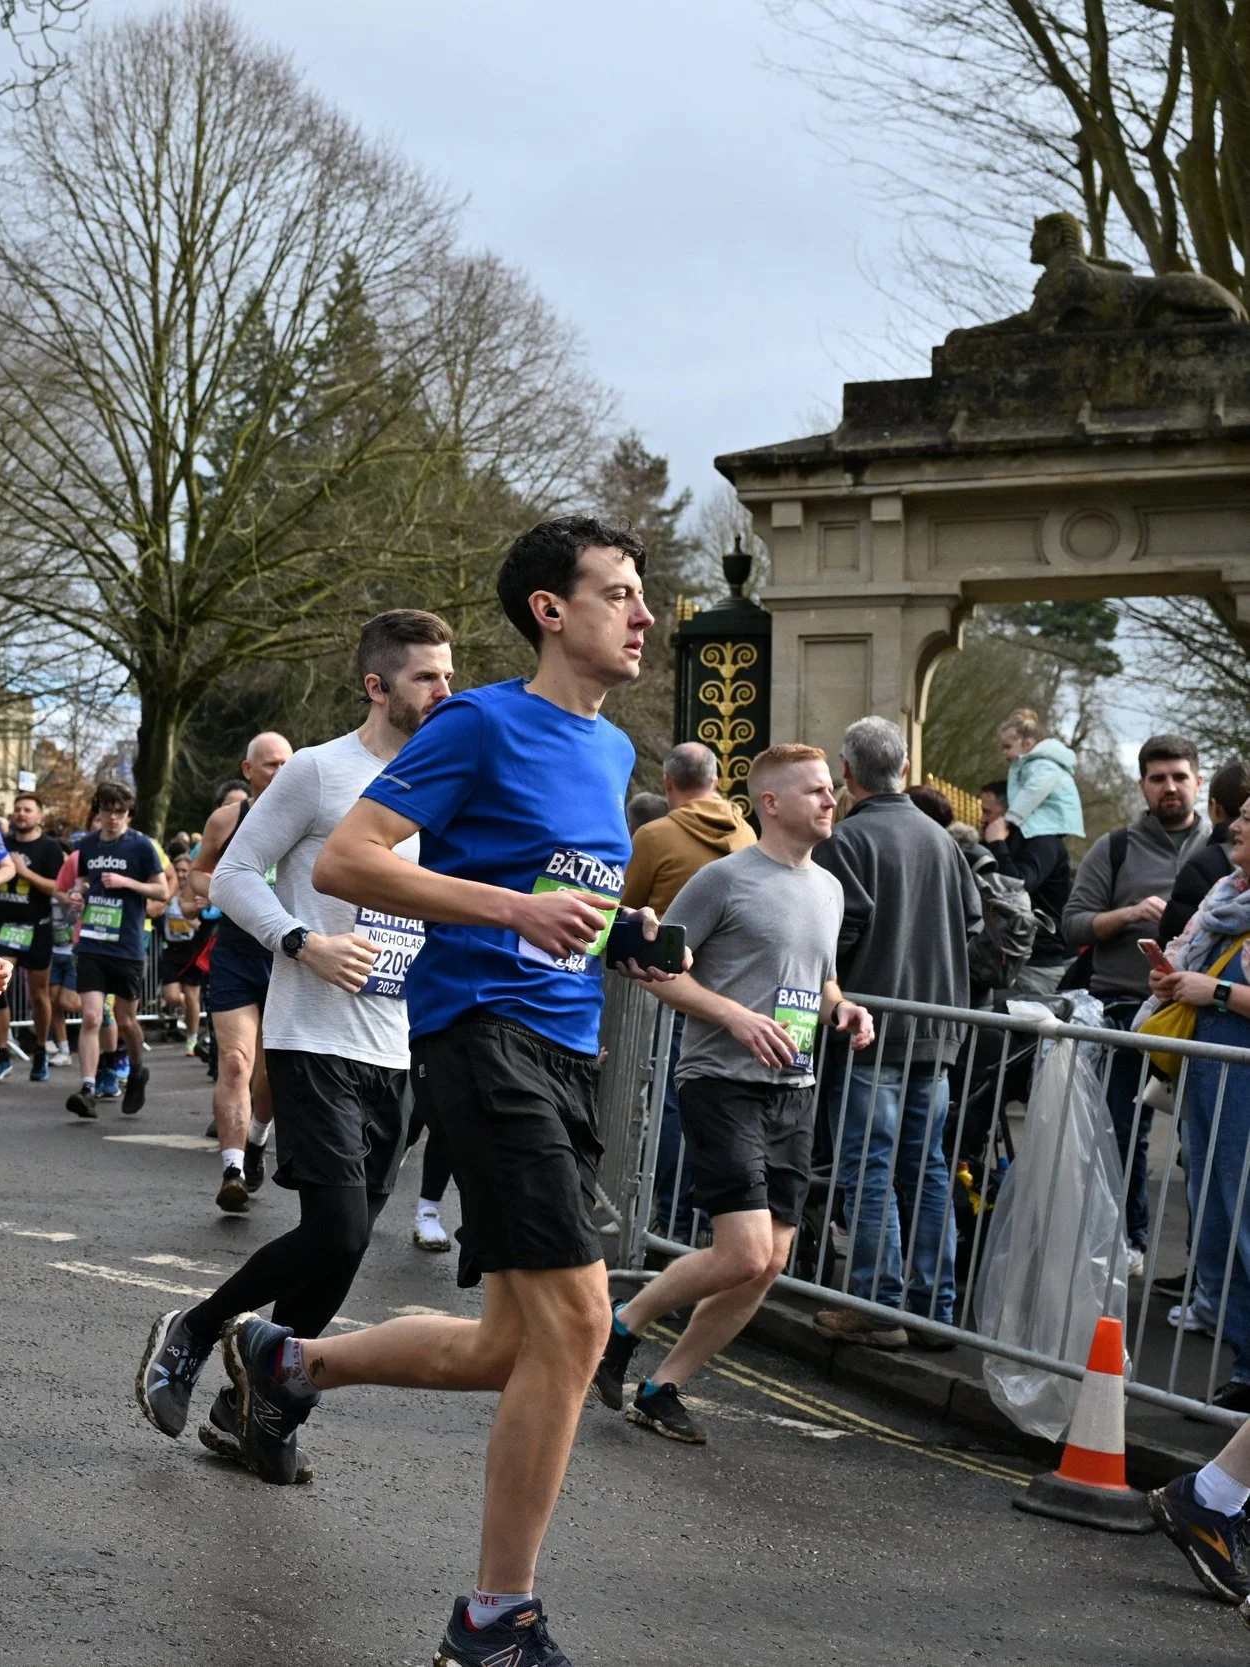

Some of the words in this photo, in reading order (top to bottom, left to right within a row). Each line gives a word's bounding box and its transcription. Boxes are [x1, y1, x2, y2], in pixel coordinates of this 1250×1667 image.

[87, 855, 127, 870] adidas
[368, 929, 422, 950] NICHOLAS
[375, 980, 401, 996] 2024
